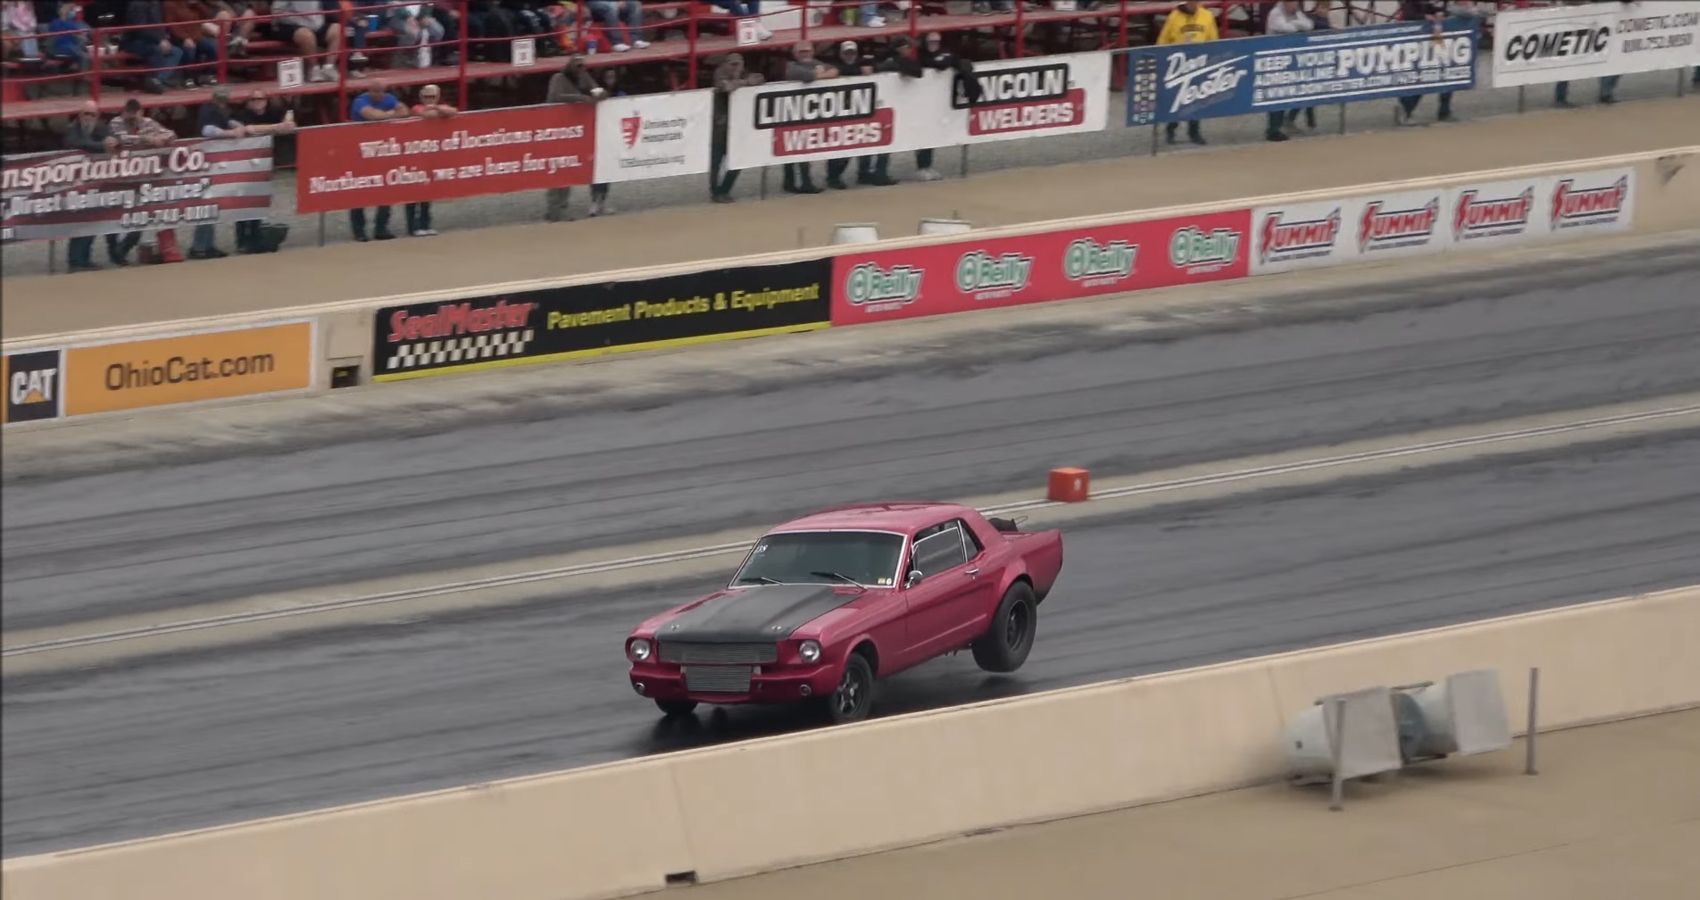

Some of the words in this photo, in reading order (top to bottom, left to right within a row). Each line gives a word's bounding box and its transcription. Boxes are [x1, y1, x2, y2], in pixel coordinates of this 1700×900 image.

[1254, 55, 1292, 72] KEEP
[1296, 51, 1335, 68] YOUR
[1337, 36, 1472, 77] PUMPING
[1506, 26, 1609, 61] COMETIC
[1164, 52, 1208, 81] Don
[1254, 66, 1336, 87] ADRENALINE
[956, 68, 1065, 105] LNCOLN
[1165, 64, 1248, 113] Tester
[758, 89, 872, 124] LINCOLN
[978, 102, 1074, 131] WELDERS
[359, 137, 401, 159] With
[441, 130, 461, 150] of
[461, 128, 532, 149] locations
[534, 124, 584, 142] across
[783, 121, 882, 152] WELDERS
[169, 146, 209, 173] Co.
[309, 171, 384, 195] Northern
[433, 167, 457, 181] we
[457, 163, 483, 179] are
[485, 157, 520, 176] here
[522, 153, 546, 172] for
[548, 154, 582, 174] you.
[10, 193, 62, 216] Direct
[66, 189, 135, 210] Delivery
[1063, 237, 1140, 281] O'Reilly
[1170, 226, 1242, 268] O'Reilly
[847, 262, 925, 306] O'Reilly
[956, 251, 1035, 294] O'Reilly
[389, 301, 535, 342] SealMaster
[547, 304, 630, 330] Pavement
[634, 295, 710, 320] Products
[714, 293, 725, 311] &
[731, 282, 820, 311] Equipment
[11, 368, 57, 405] CAT
[105, 353, 274, 391] OhioCat.com
